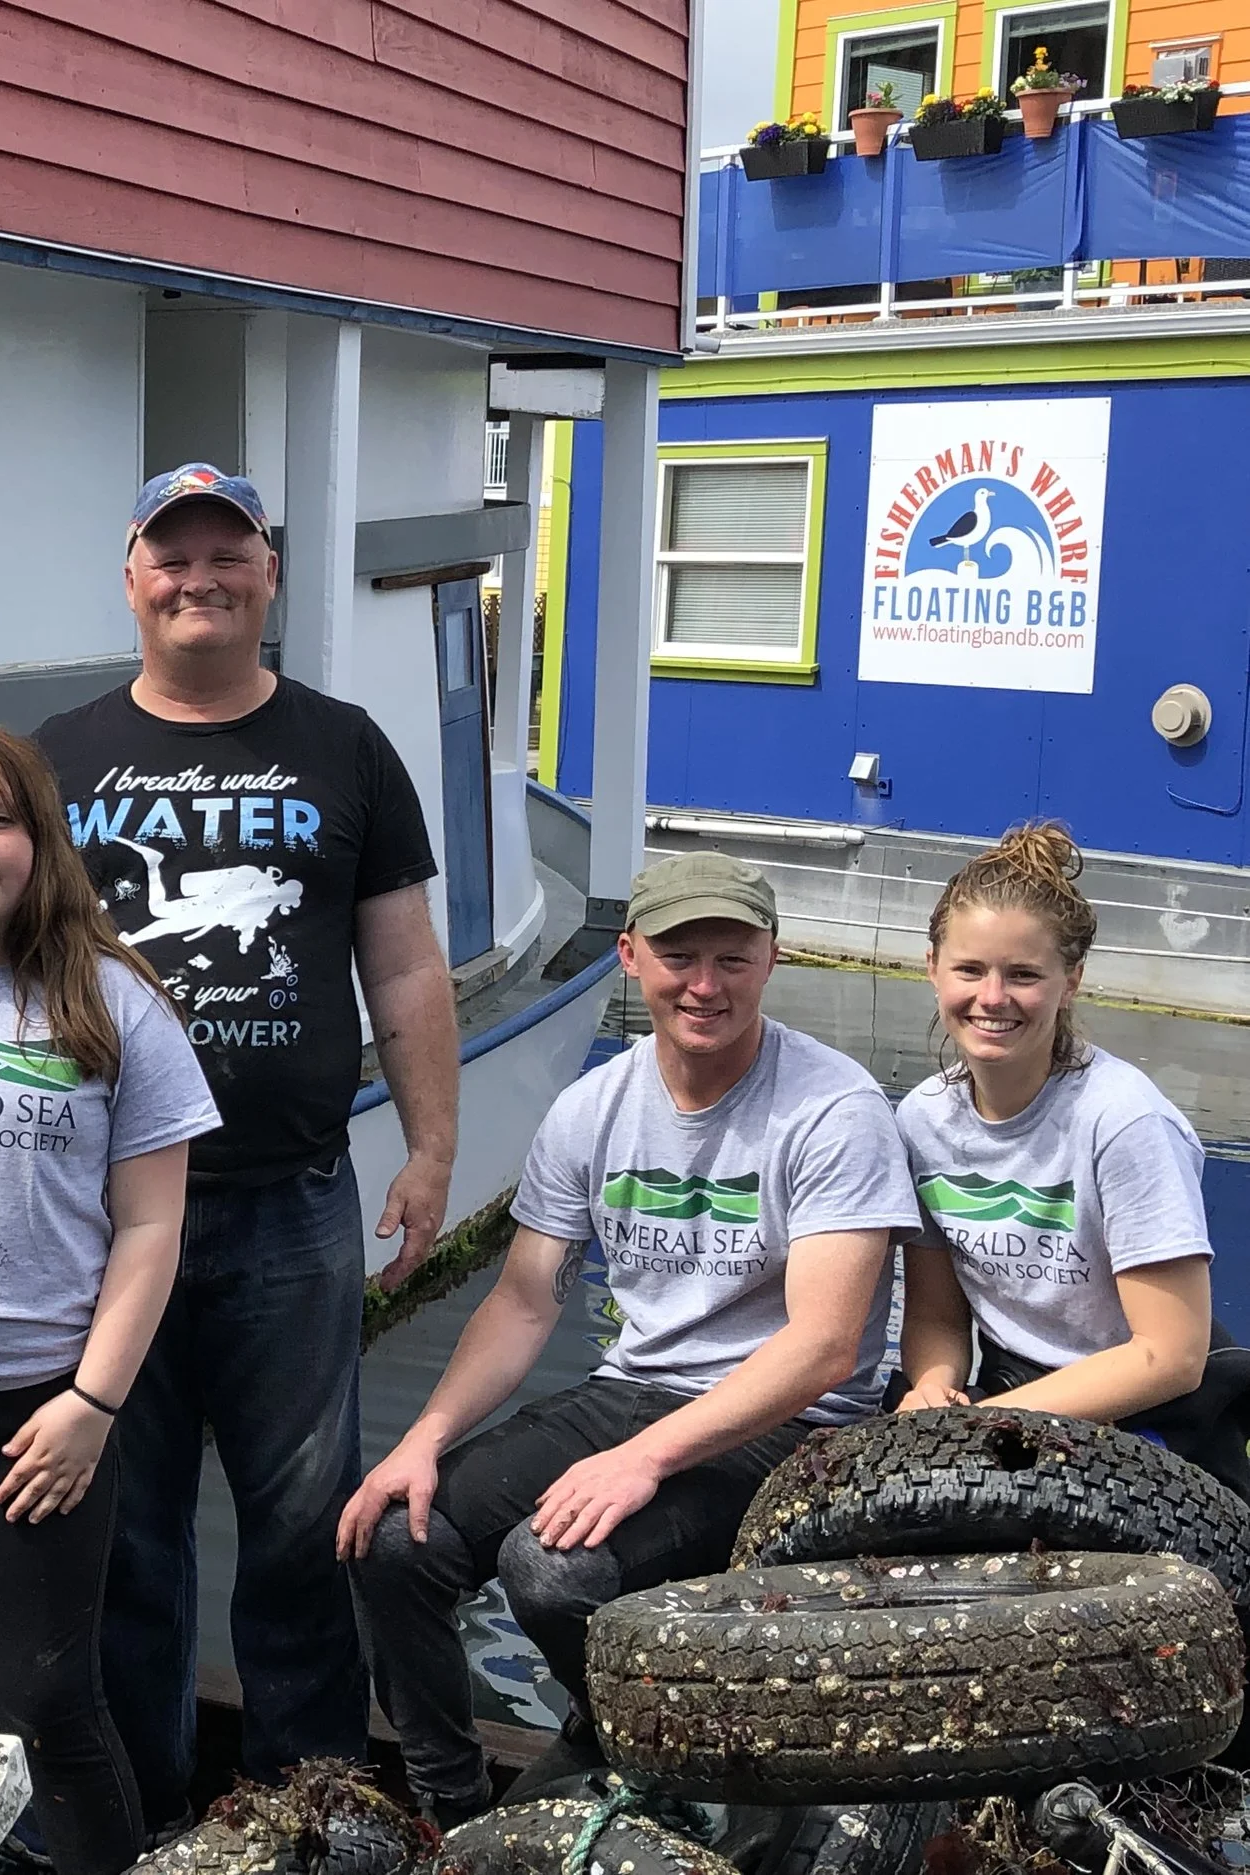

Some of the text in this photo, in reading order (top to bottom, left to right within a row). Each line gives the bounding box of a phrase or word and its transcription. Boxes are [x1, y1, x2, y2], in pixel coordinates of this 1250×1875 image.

[874, 440, 1089, 584] FISHERMAN'S WHARF
[873, 585, 1087, 627] FLOATING B&B
[872, 623, 1085, 649] www.floatingbandb.com
[94, 764, 298, 793] I breathe under
[66, 796, 323, 850] WATER
[193, 984, 259, 1011] your
[16, 1093, 77, 1129] SEA
[603, 1216, 768, 1255] EMERAL SEA
[1037, 1235, 1088, 1264] SEA
[1015, 1263, 1092, 1285] SOCIETY
